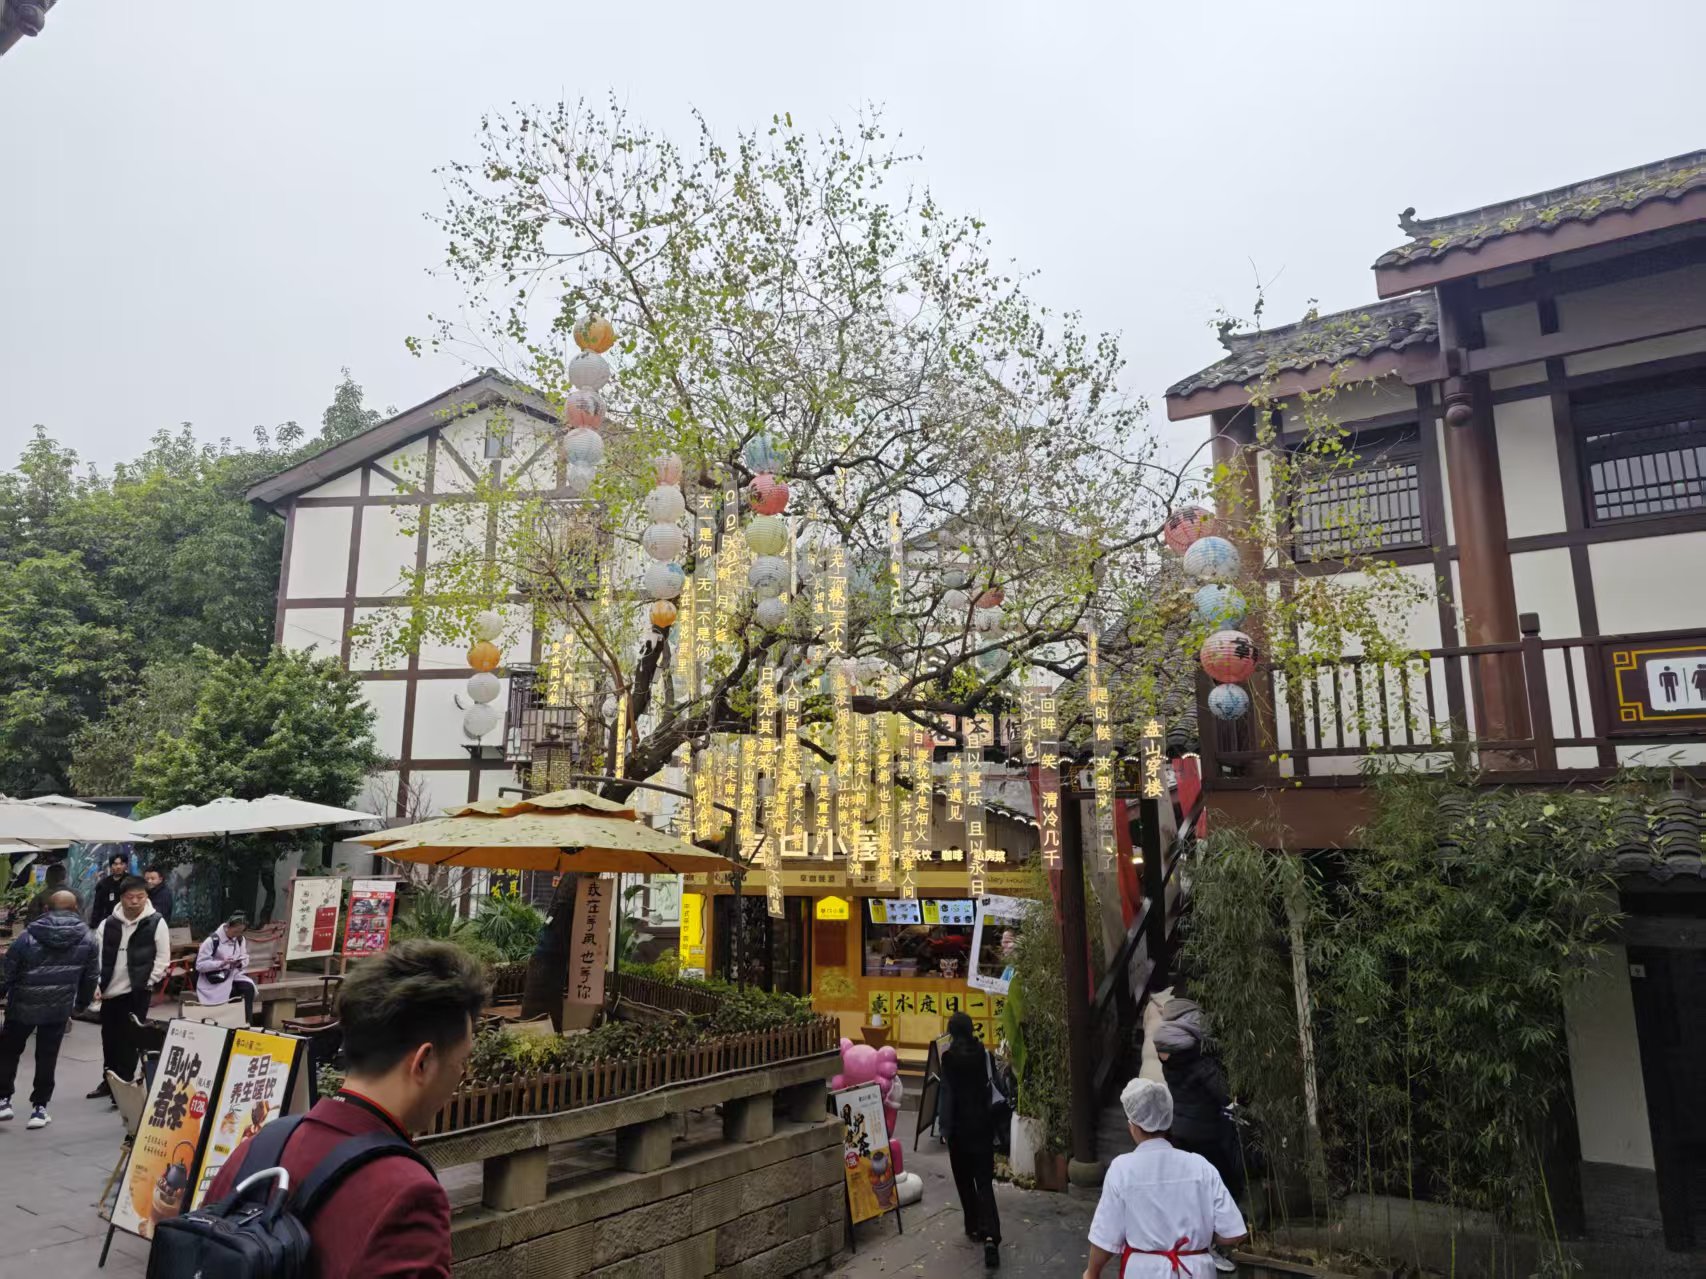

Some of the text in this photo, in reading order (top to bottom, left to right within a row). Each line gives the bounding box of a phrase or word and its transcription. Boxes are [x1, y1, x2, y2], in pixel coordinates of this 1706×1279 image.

[696, 495, 714, 659] 无一是你 无一不是你
[1095, 687, 1112, 741] 是时候
[948, 754, 963, 821] 有幸遇见
[1041, 698, 1061, 867] 回眸一笑 清冷几千
[1144, 718, 1164, 798] 盘山穿楼
[966, 734, 985, 896] 且以喜乐 且以永日
[164, 1045, 203, 1091] 围炉
[230, 1076, 278, 1104] 养生暖饮
[247, 1055, 272, 1079] 冬日
[148, 1077, 189, 1129] 煮茶
